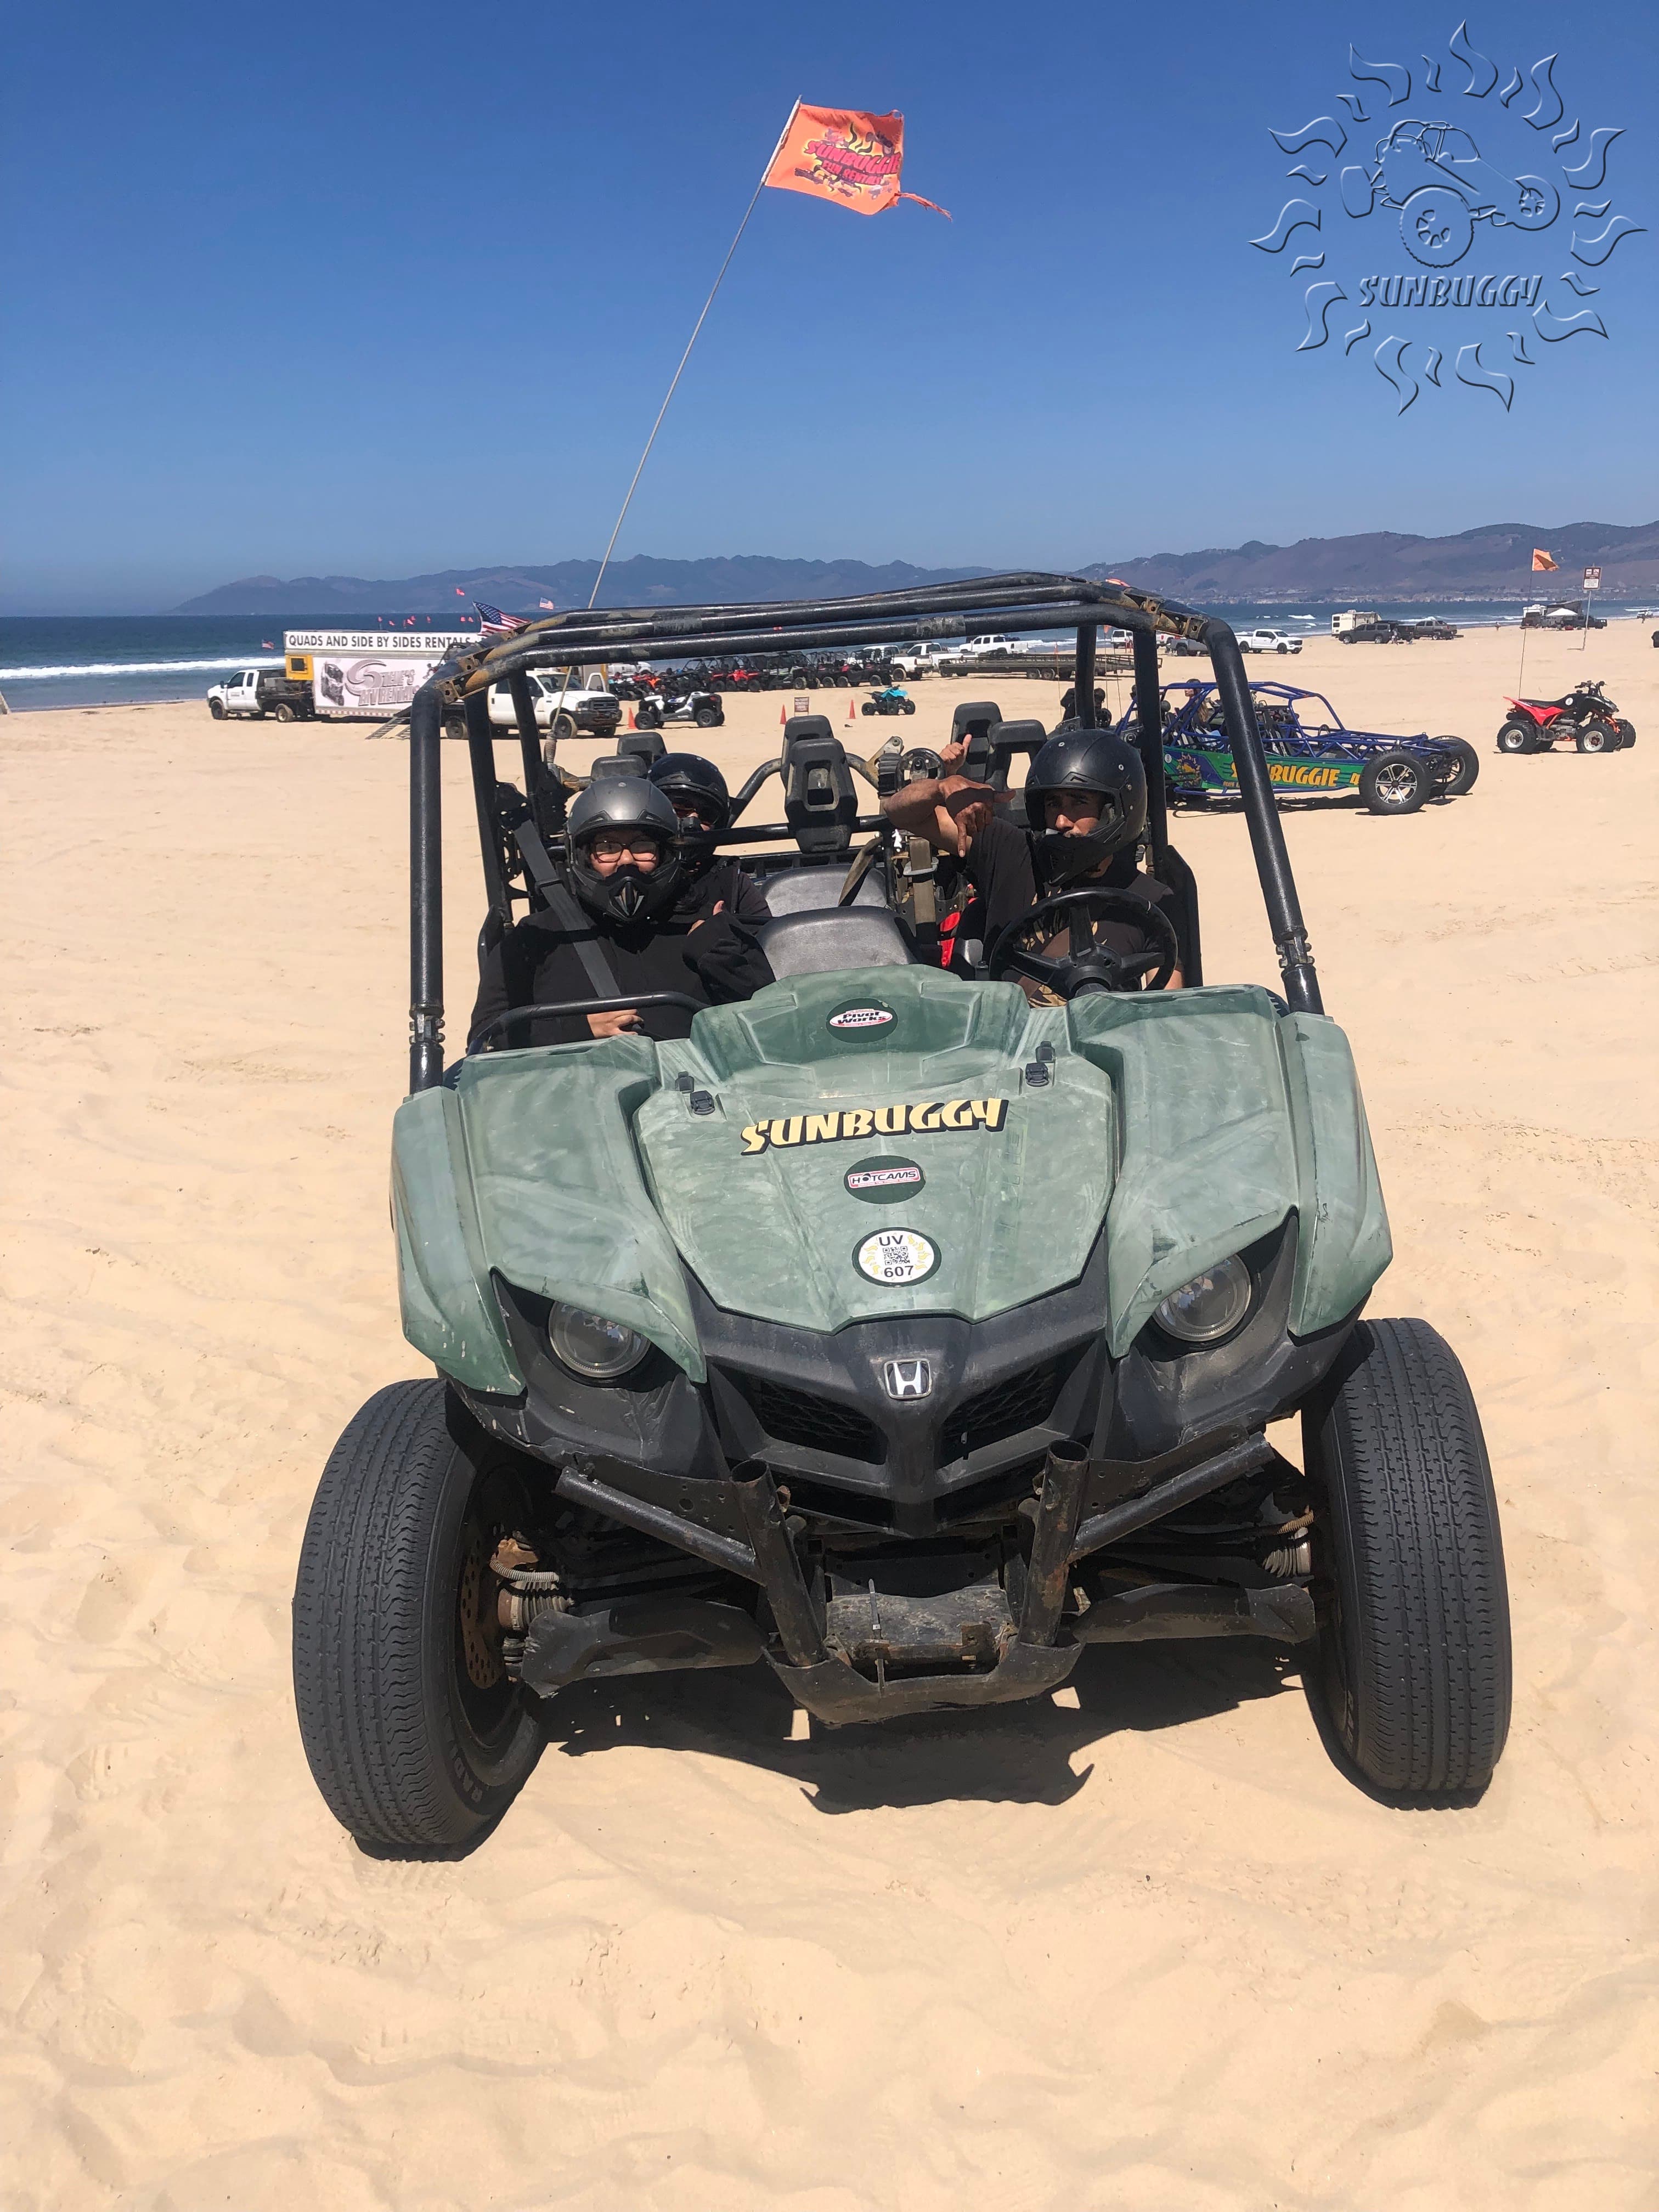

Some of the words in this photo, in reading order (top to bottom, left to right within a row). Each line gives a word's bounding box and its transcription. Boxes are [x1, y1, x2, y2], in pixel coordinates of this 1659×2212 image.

[289, 635, 323, 646] QUADS
[326, 635, 348, 646] AND
[351, 636, 374, 647] SIDE
[377, 636, 390, 647] BY
[392, 636, 421, 648] SIDES
[741, 1098, 1008, 1155] SUNBUGGY
[879, 1235, 903, 1246] UV
[884, 1265, 913, 1278] 607
